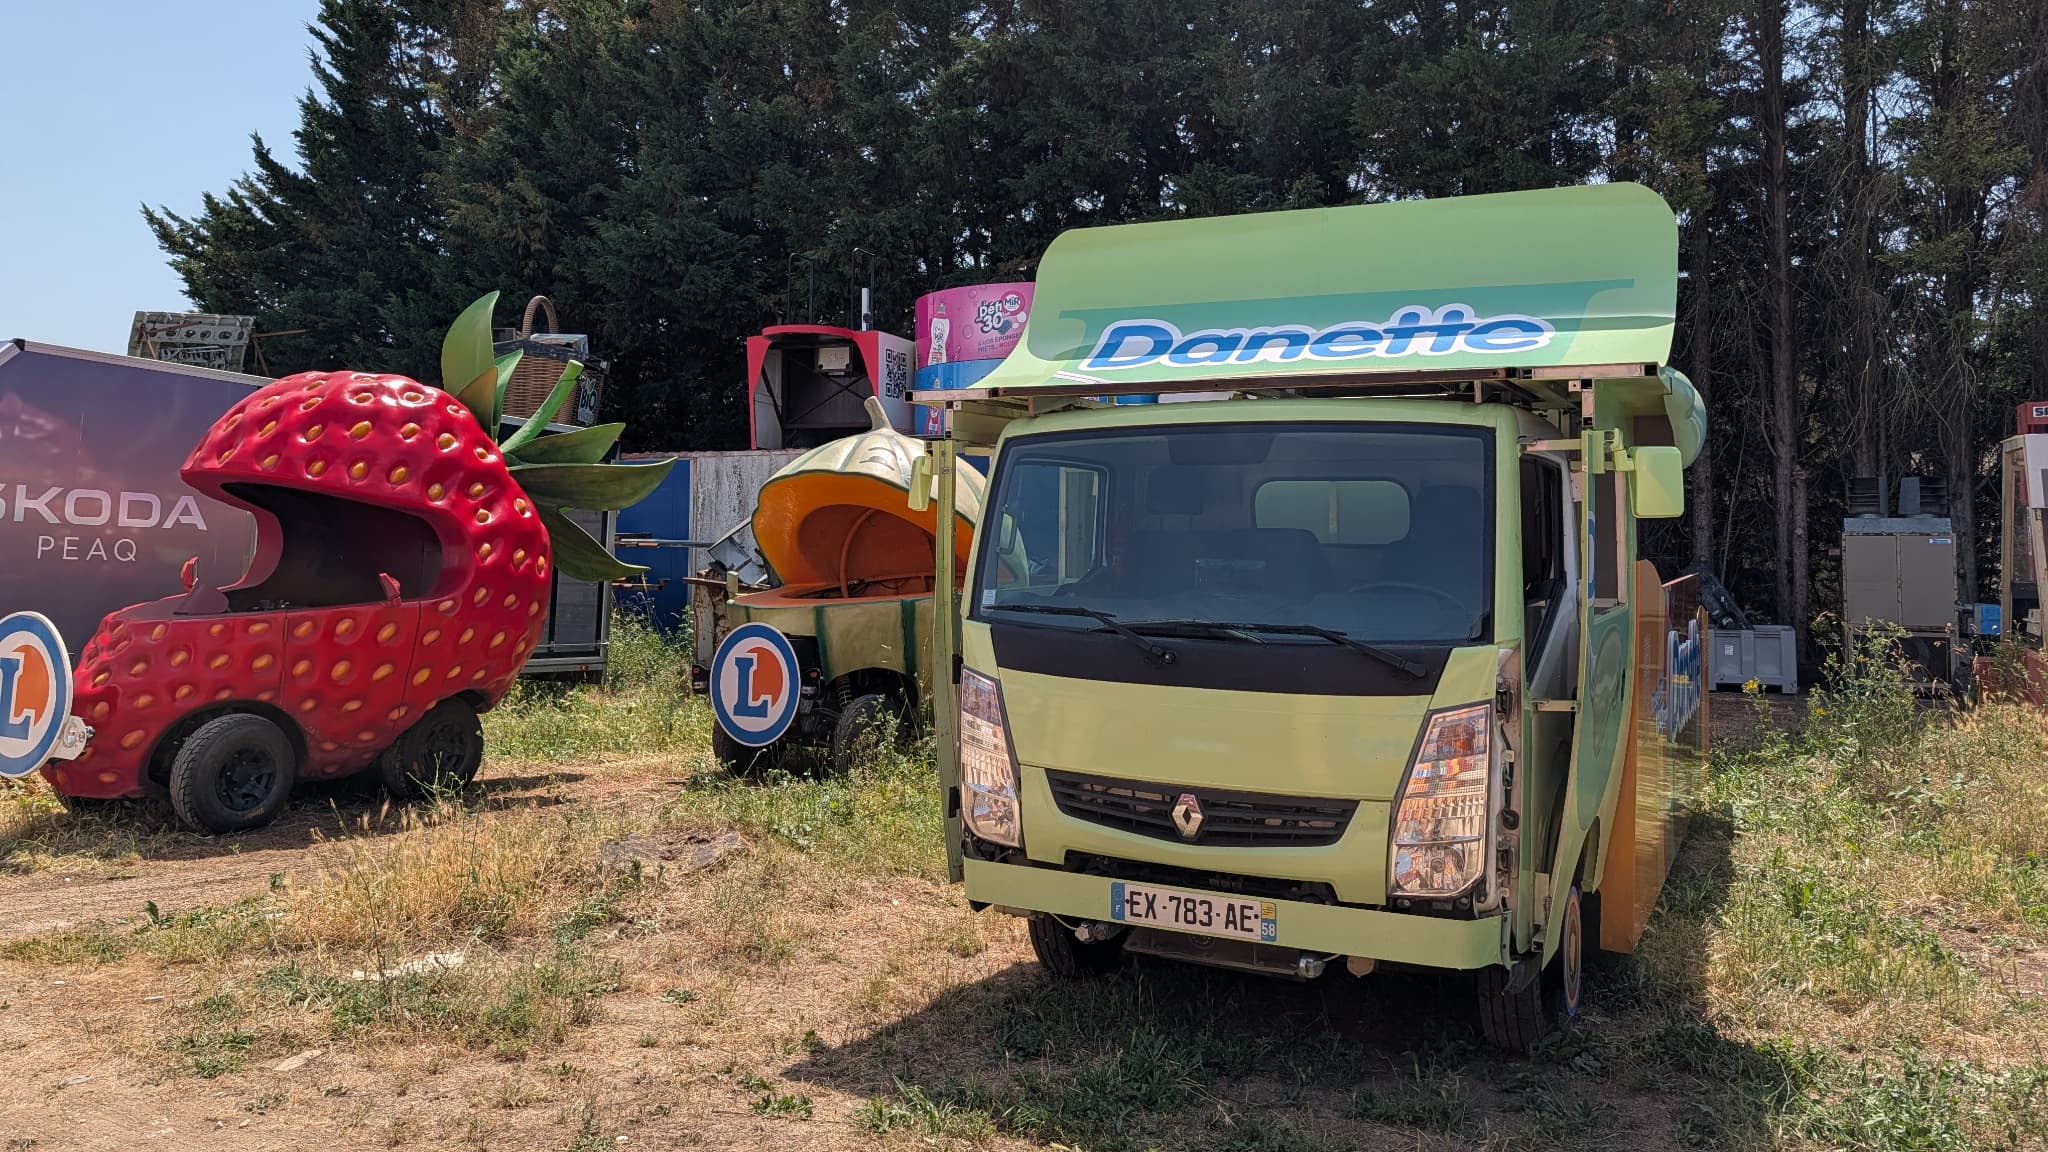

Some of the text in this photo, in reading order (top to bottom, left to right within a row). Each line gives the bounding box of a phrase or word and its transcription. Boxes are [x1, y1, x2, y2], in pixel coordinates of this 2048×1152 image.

[1083, 306, 1550, 369] Danette
[0, 483, 208, 531] KODA
[37, 535, 137, 562] PEAQ
[733, 656, 769, 718] L
[1115, 904, 1121, 912] F
[1261, 922, 1276, 937] 58
